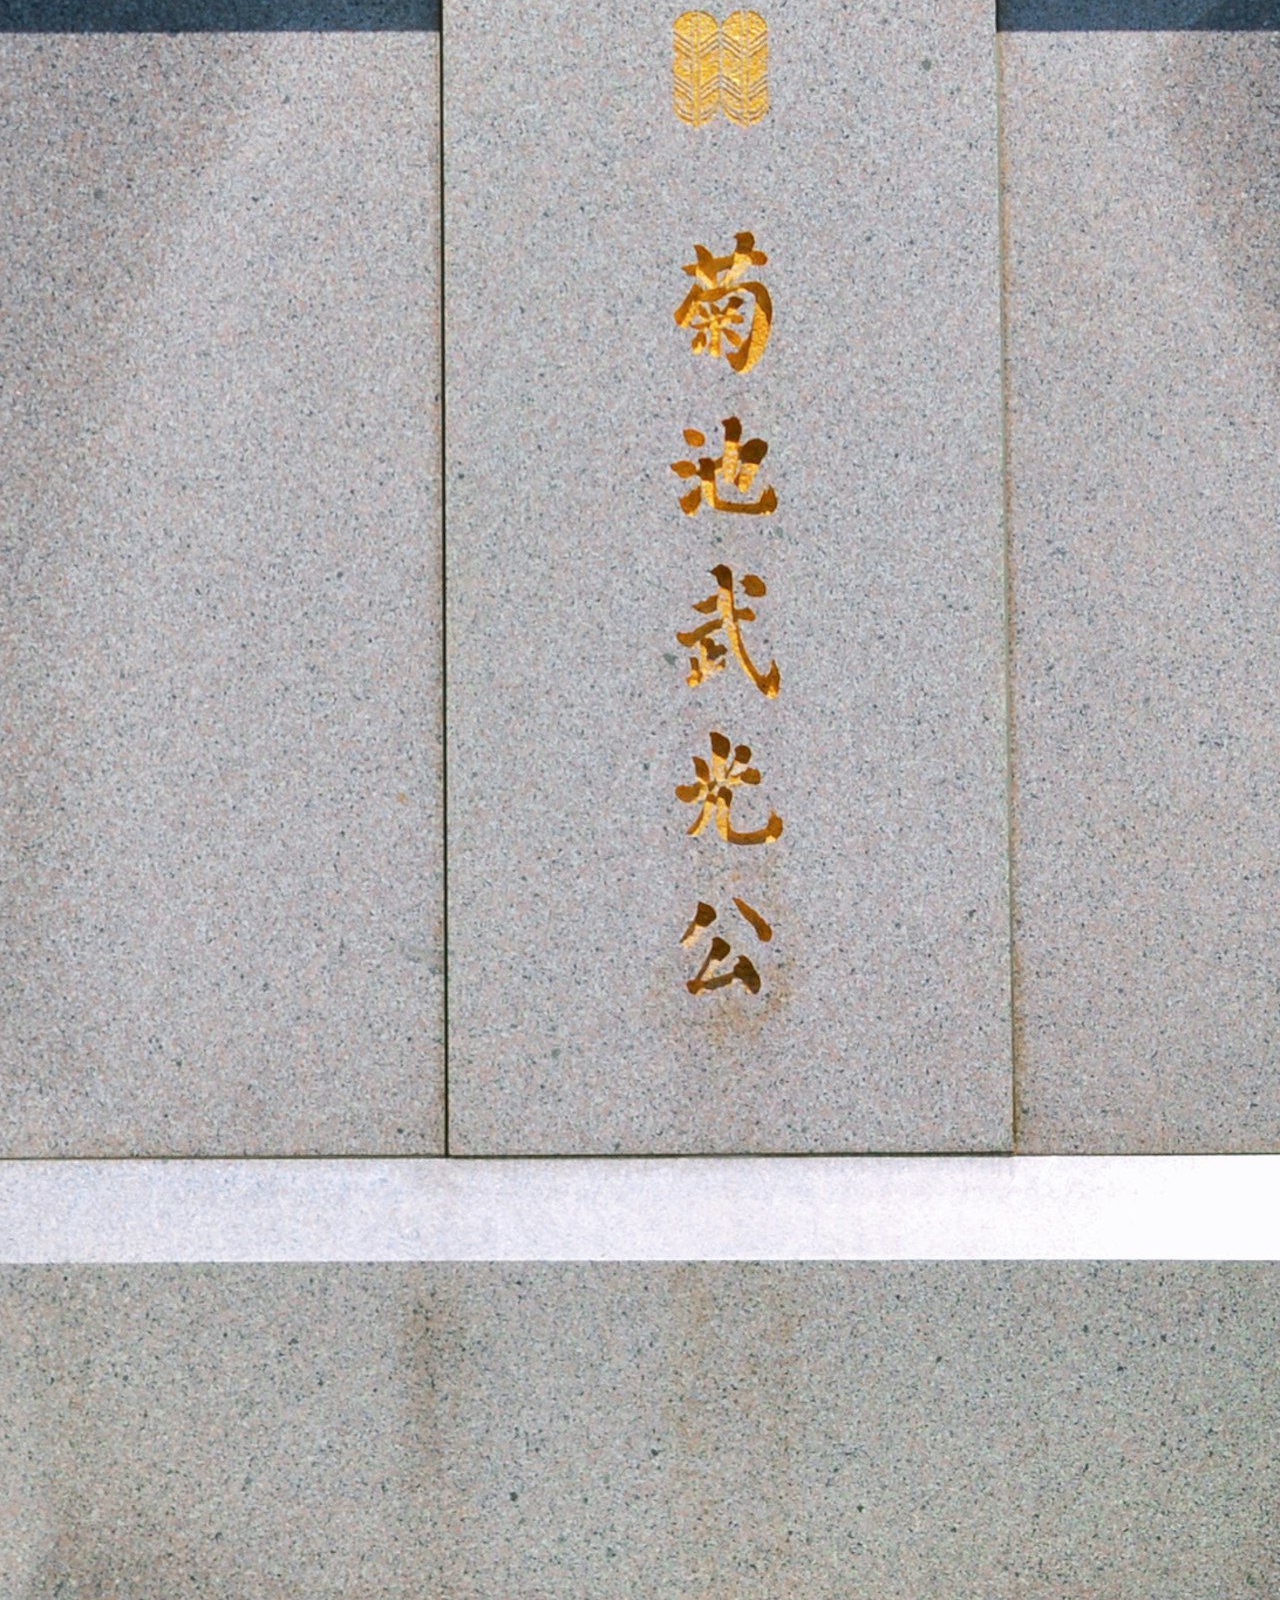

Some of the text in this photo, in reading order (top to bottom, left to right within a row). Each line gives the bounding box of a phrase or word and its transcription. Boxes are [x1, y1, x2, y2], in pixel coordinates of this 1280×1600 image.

[670, 231, 783, 995] 菊池武光公
